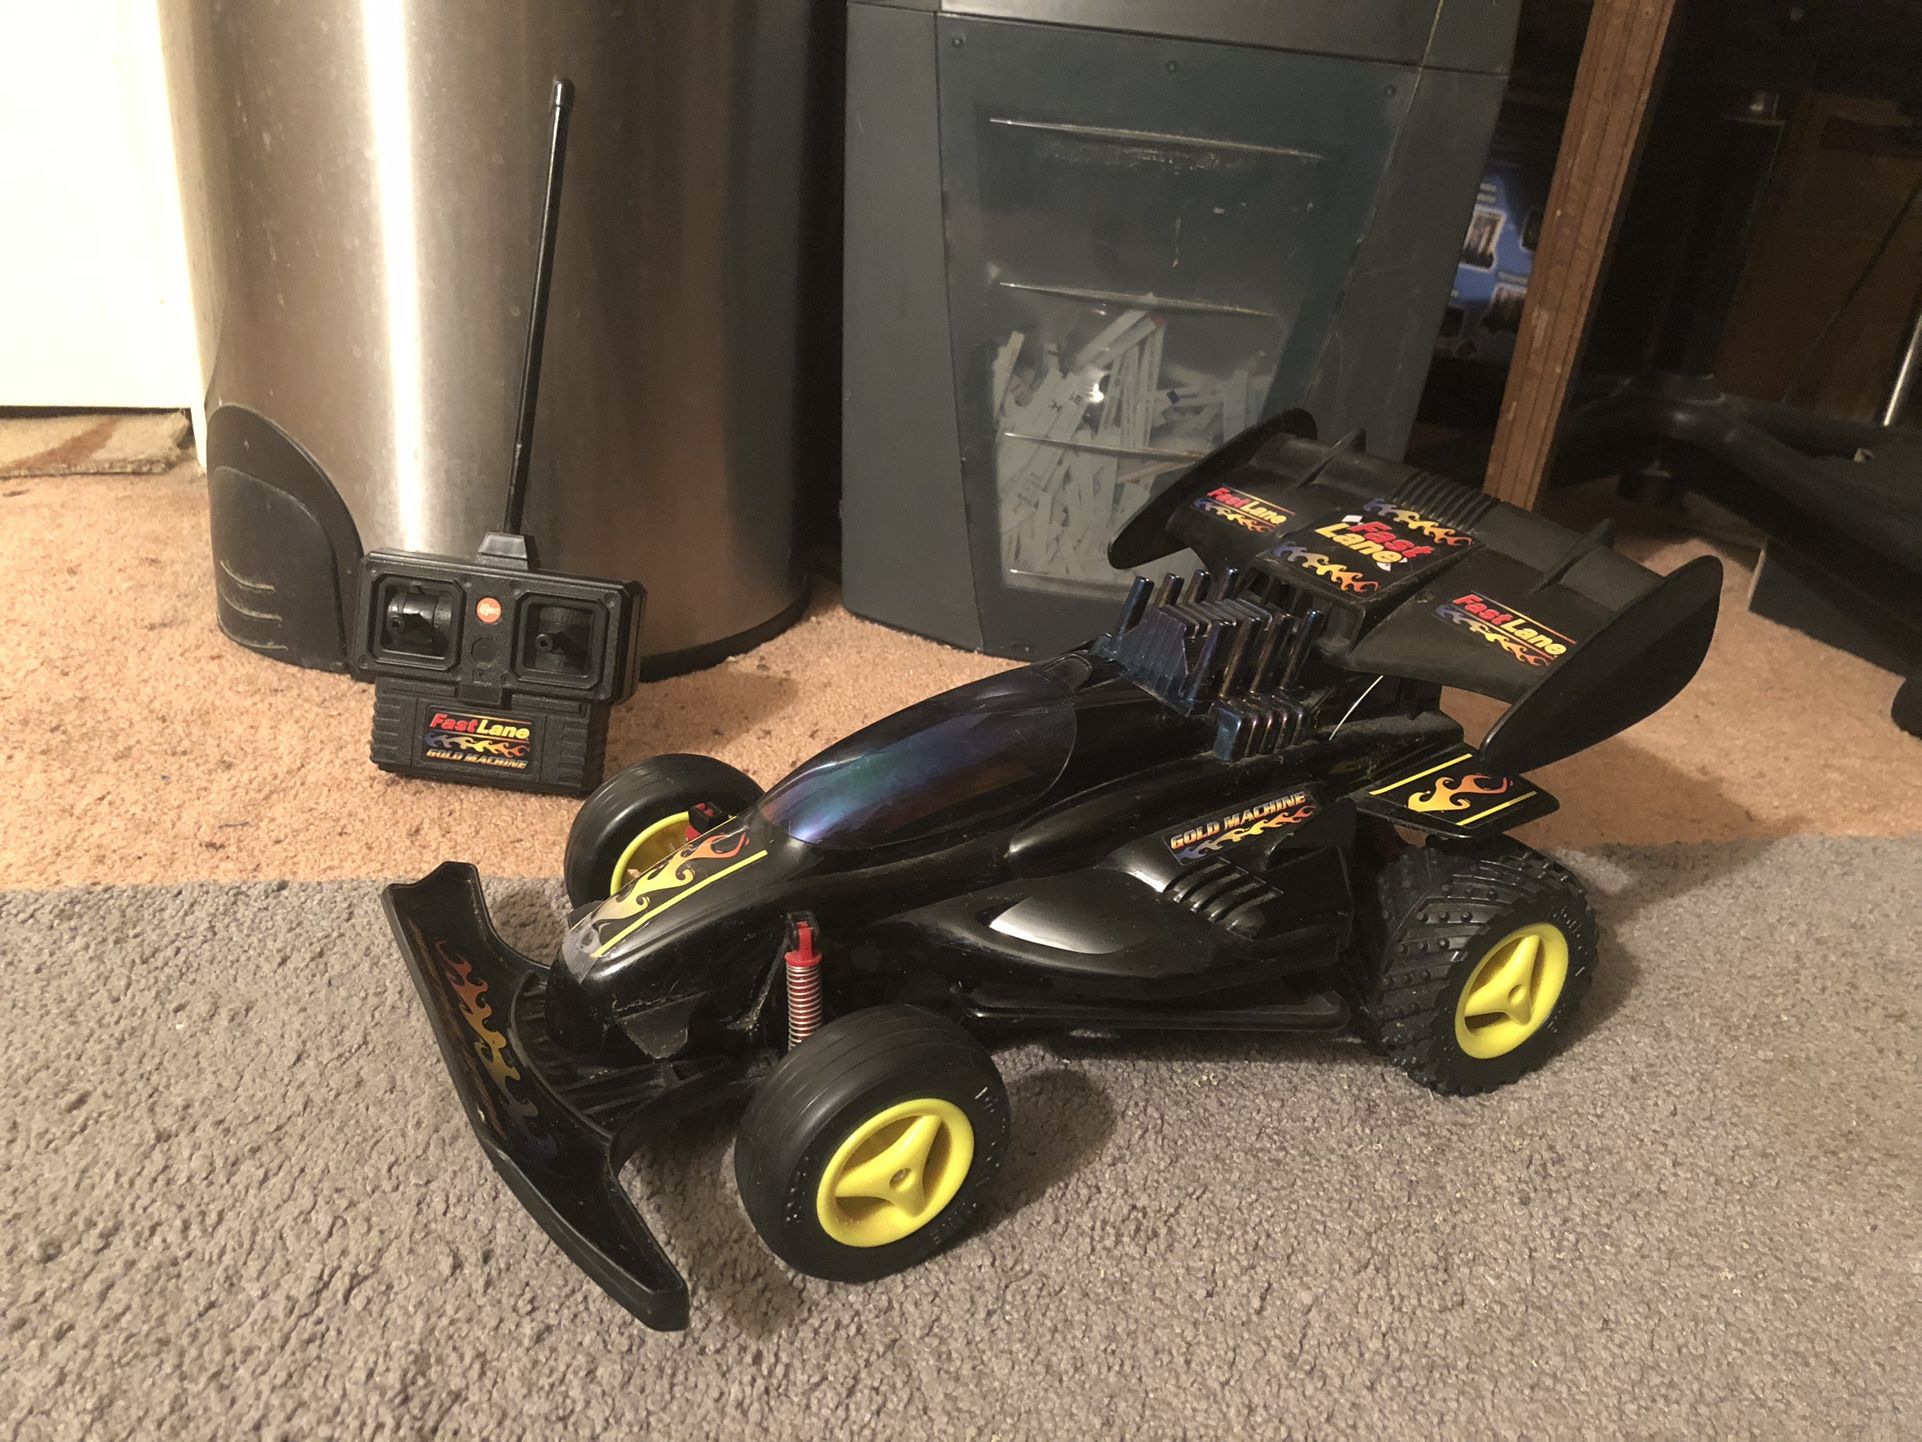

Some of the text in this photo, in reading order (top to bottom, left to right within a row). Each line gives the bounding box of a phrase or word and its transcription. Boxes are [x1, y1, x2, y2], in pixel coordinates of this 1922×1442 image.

[1313, 522, 1402, 563] Lane
[1347, 521, 1435, 558] Fast
[426, 748, 528, 770] GOLD MACHINE
[1170, 791, 1306, 850] GOLD MACHINE
